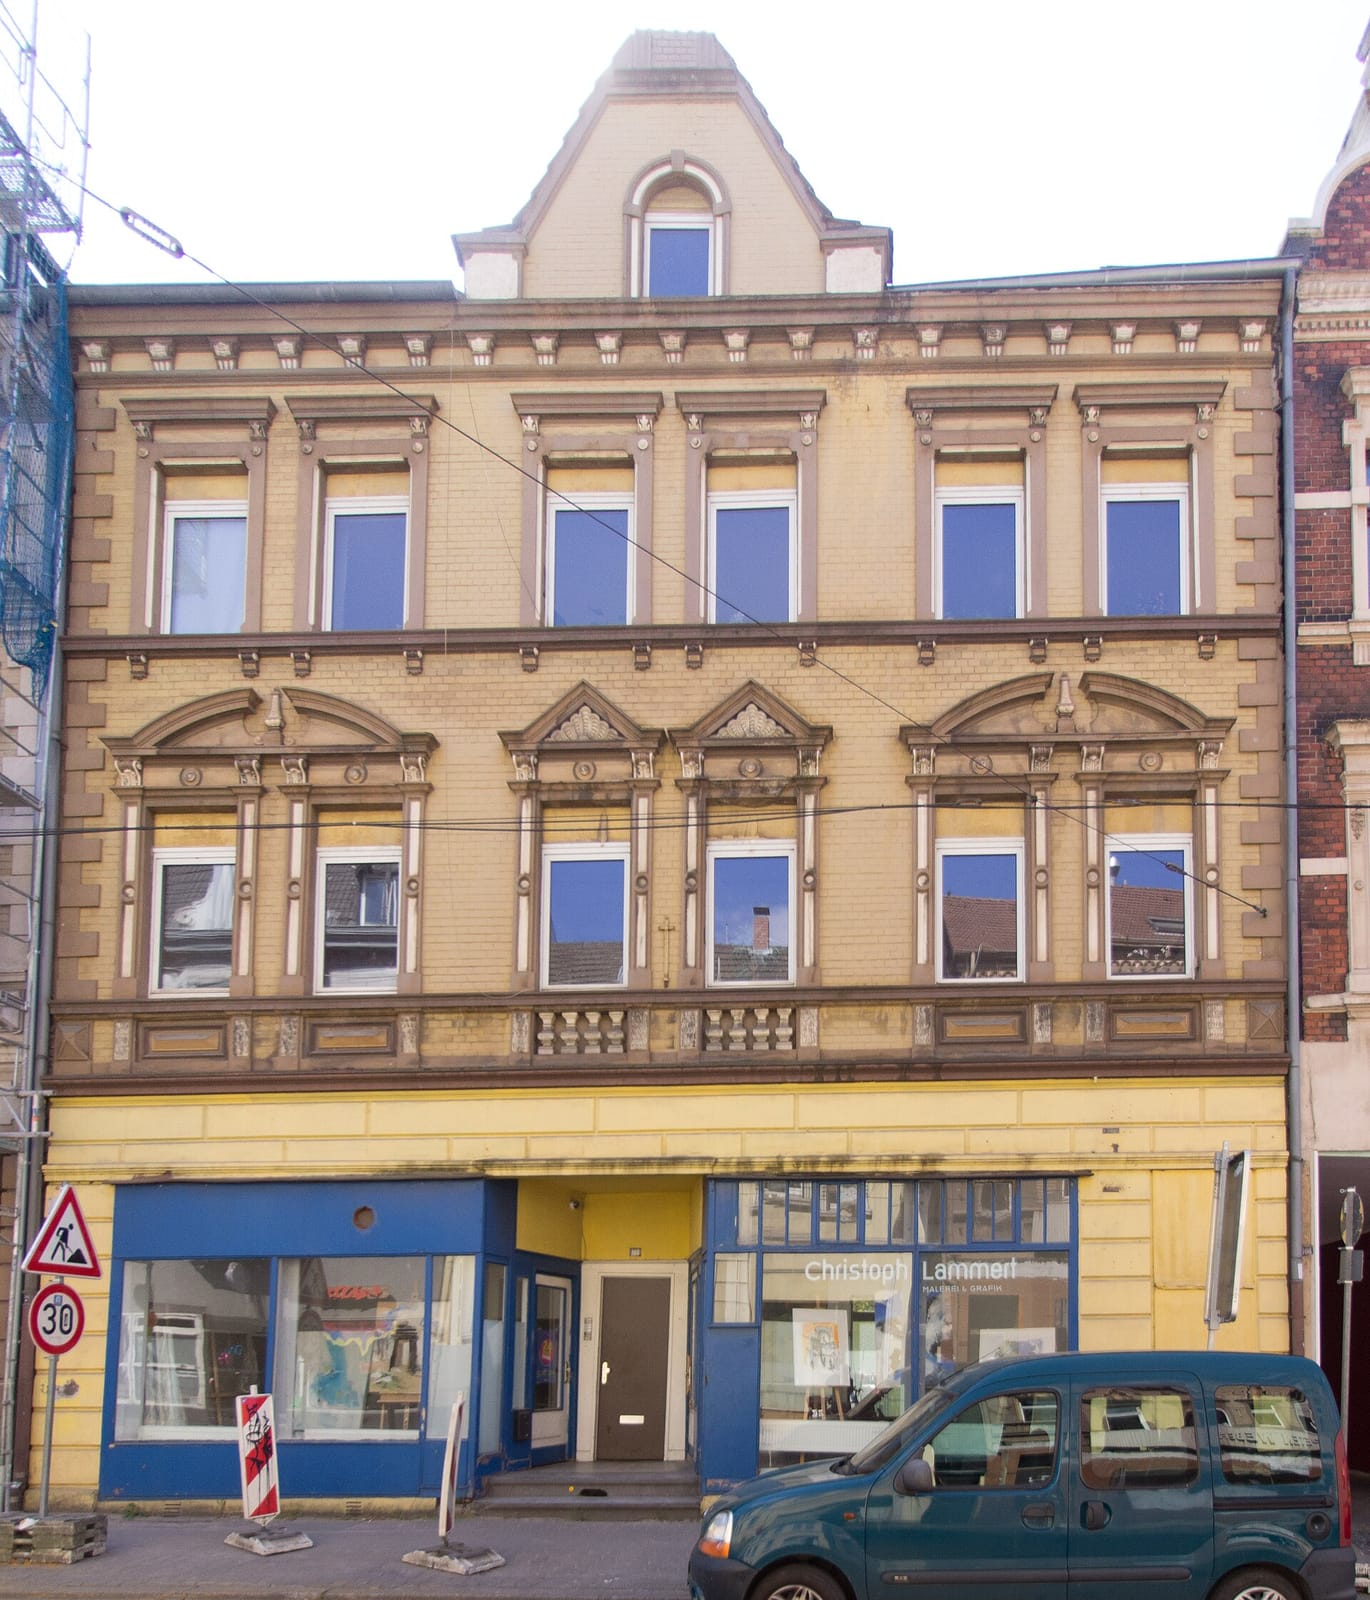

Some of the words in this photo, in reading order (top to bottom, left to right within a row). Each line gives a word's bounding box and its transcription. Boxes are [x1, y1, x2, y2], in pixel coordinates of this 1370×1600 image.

[804, 1258, 908, 1285] Christoph
[922, 1257, 1017, 1281] Lammert
[922, 1285, 960, 1294] MALEREI
[969, 1284, 1003, 1293] GRAFIK
[42, 1303, 73, 1335] 30
